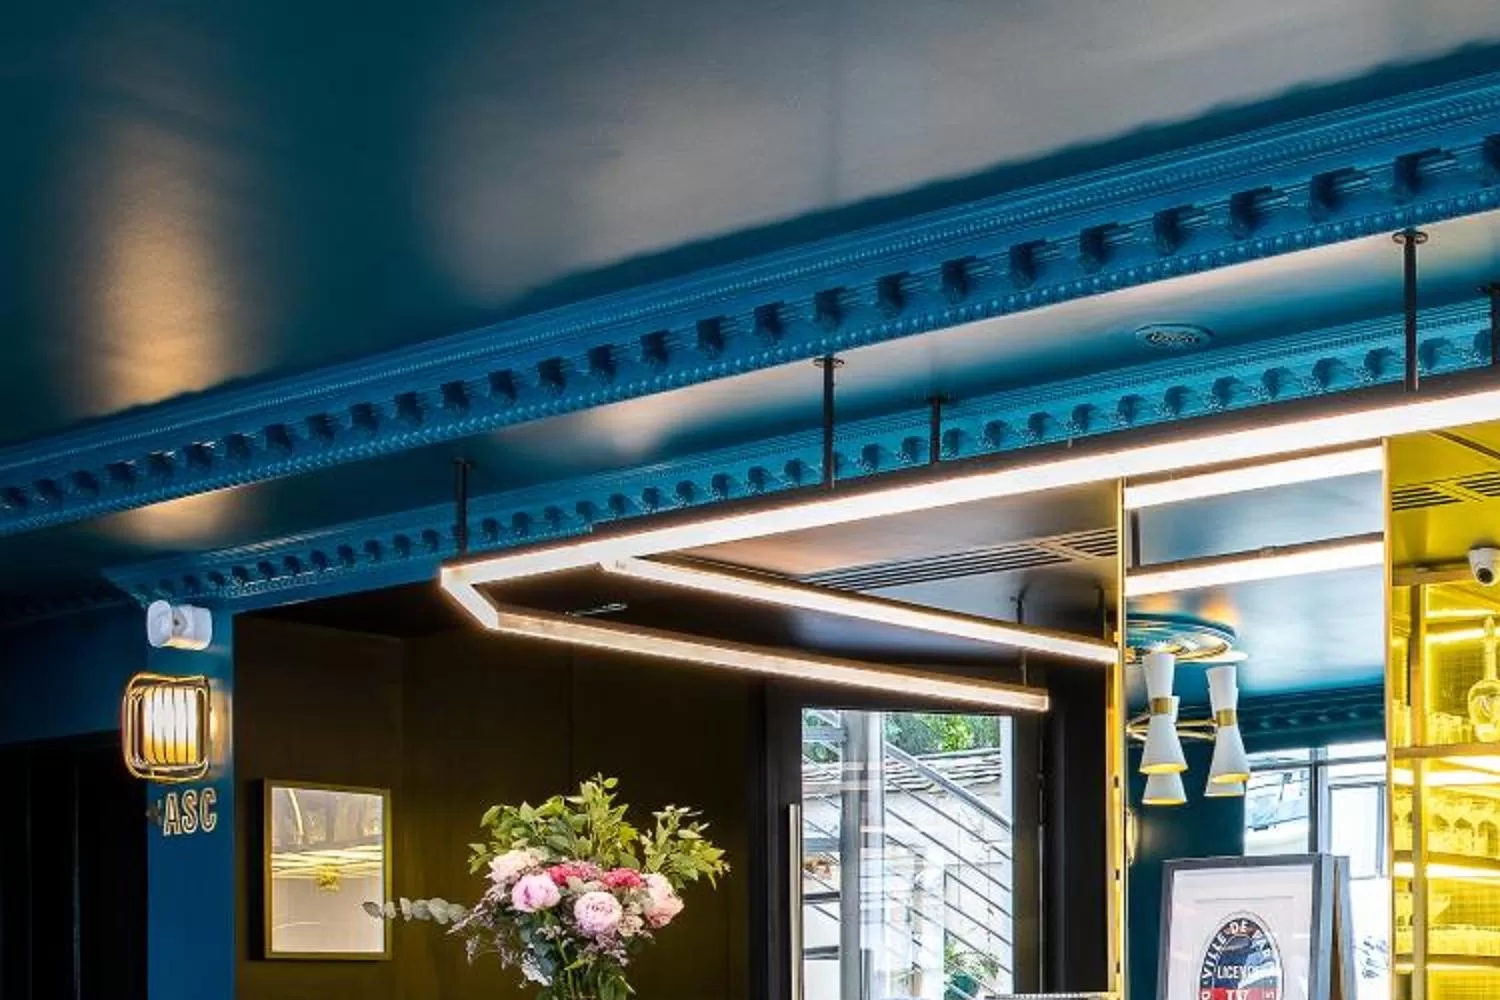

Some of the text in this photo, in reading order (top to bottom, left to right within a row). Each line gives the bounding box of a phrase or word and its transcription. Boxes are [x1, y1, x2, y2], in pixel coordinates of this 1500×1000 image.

[163, 787, 217, 836] ASC
[1201, 934, 1227, 979] VILLE
[1229, 920, 1249, 935] DE
